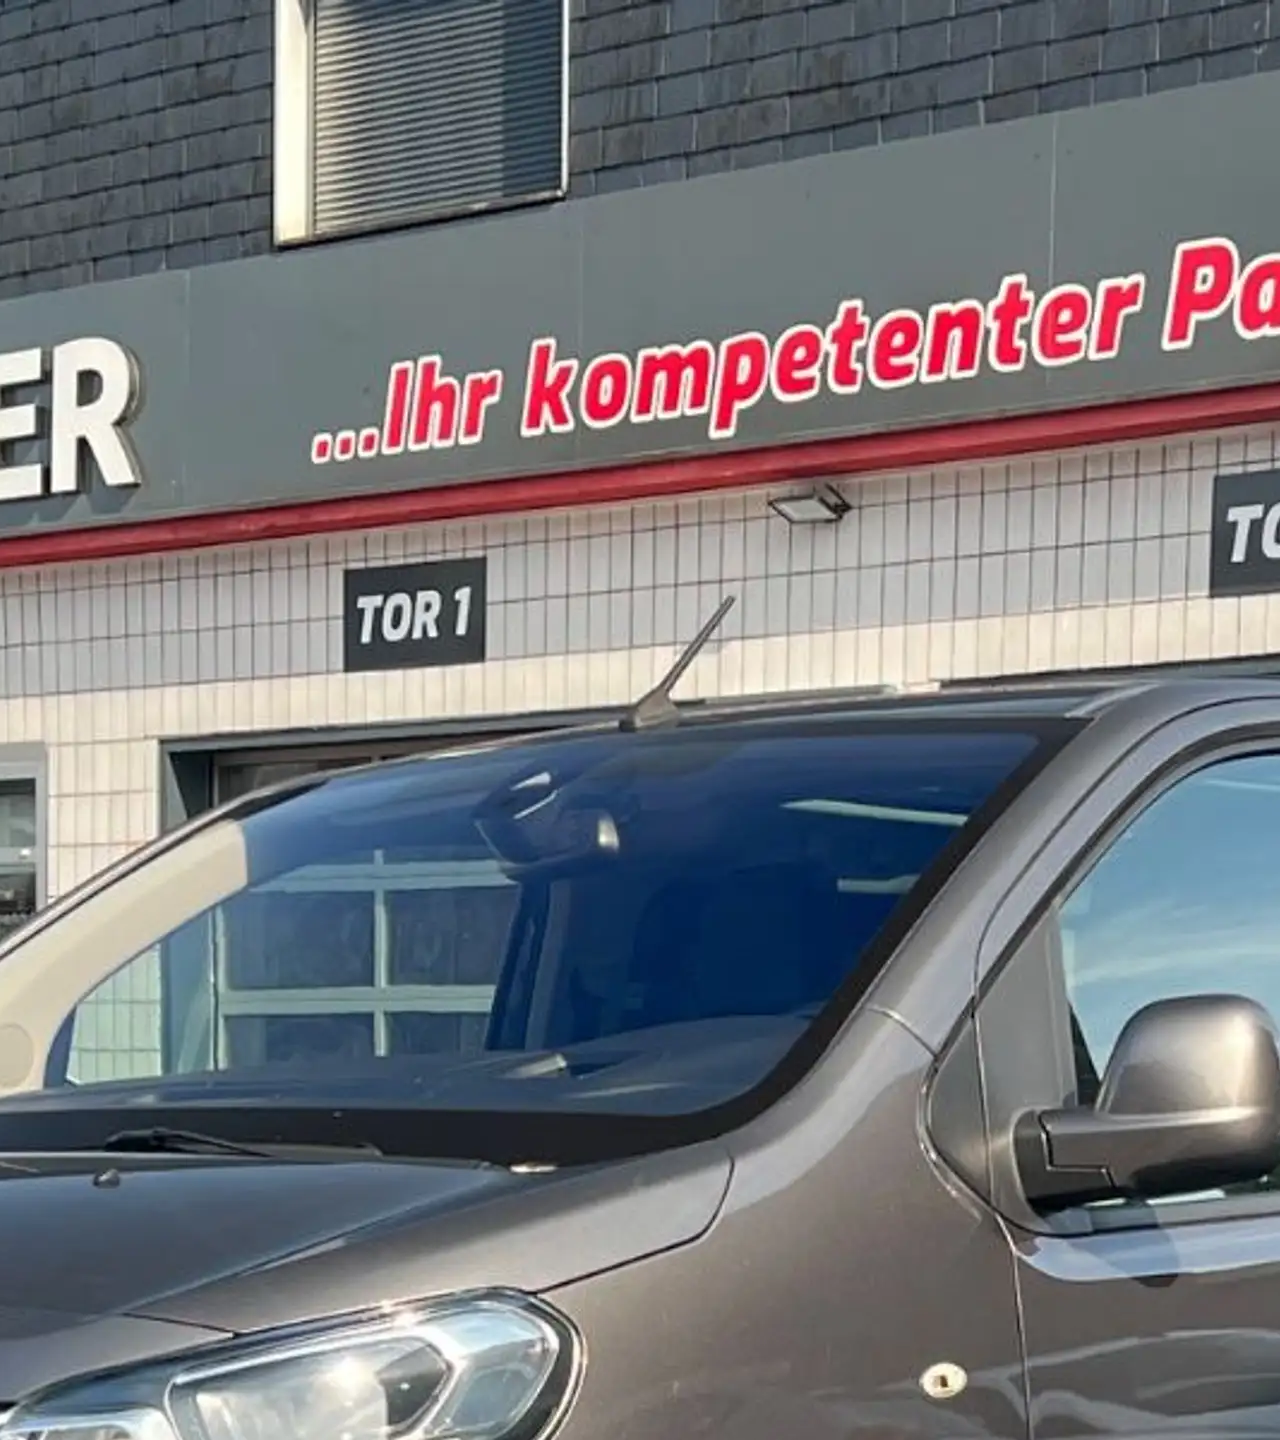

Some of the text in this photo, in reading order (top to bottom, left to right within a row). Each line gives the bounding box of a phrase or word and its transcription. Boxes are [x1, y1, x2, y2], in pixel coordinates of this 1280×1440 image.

[311, 355, 502, 465] ...Ihr
[520, 271, 1146, 438] kompetenter
[356, 585, 472, 645] TOR 1
